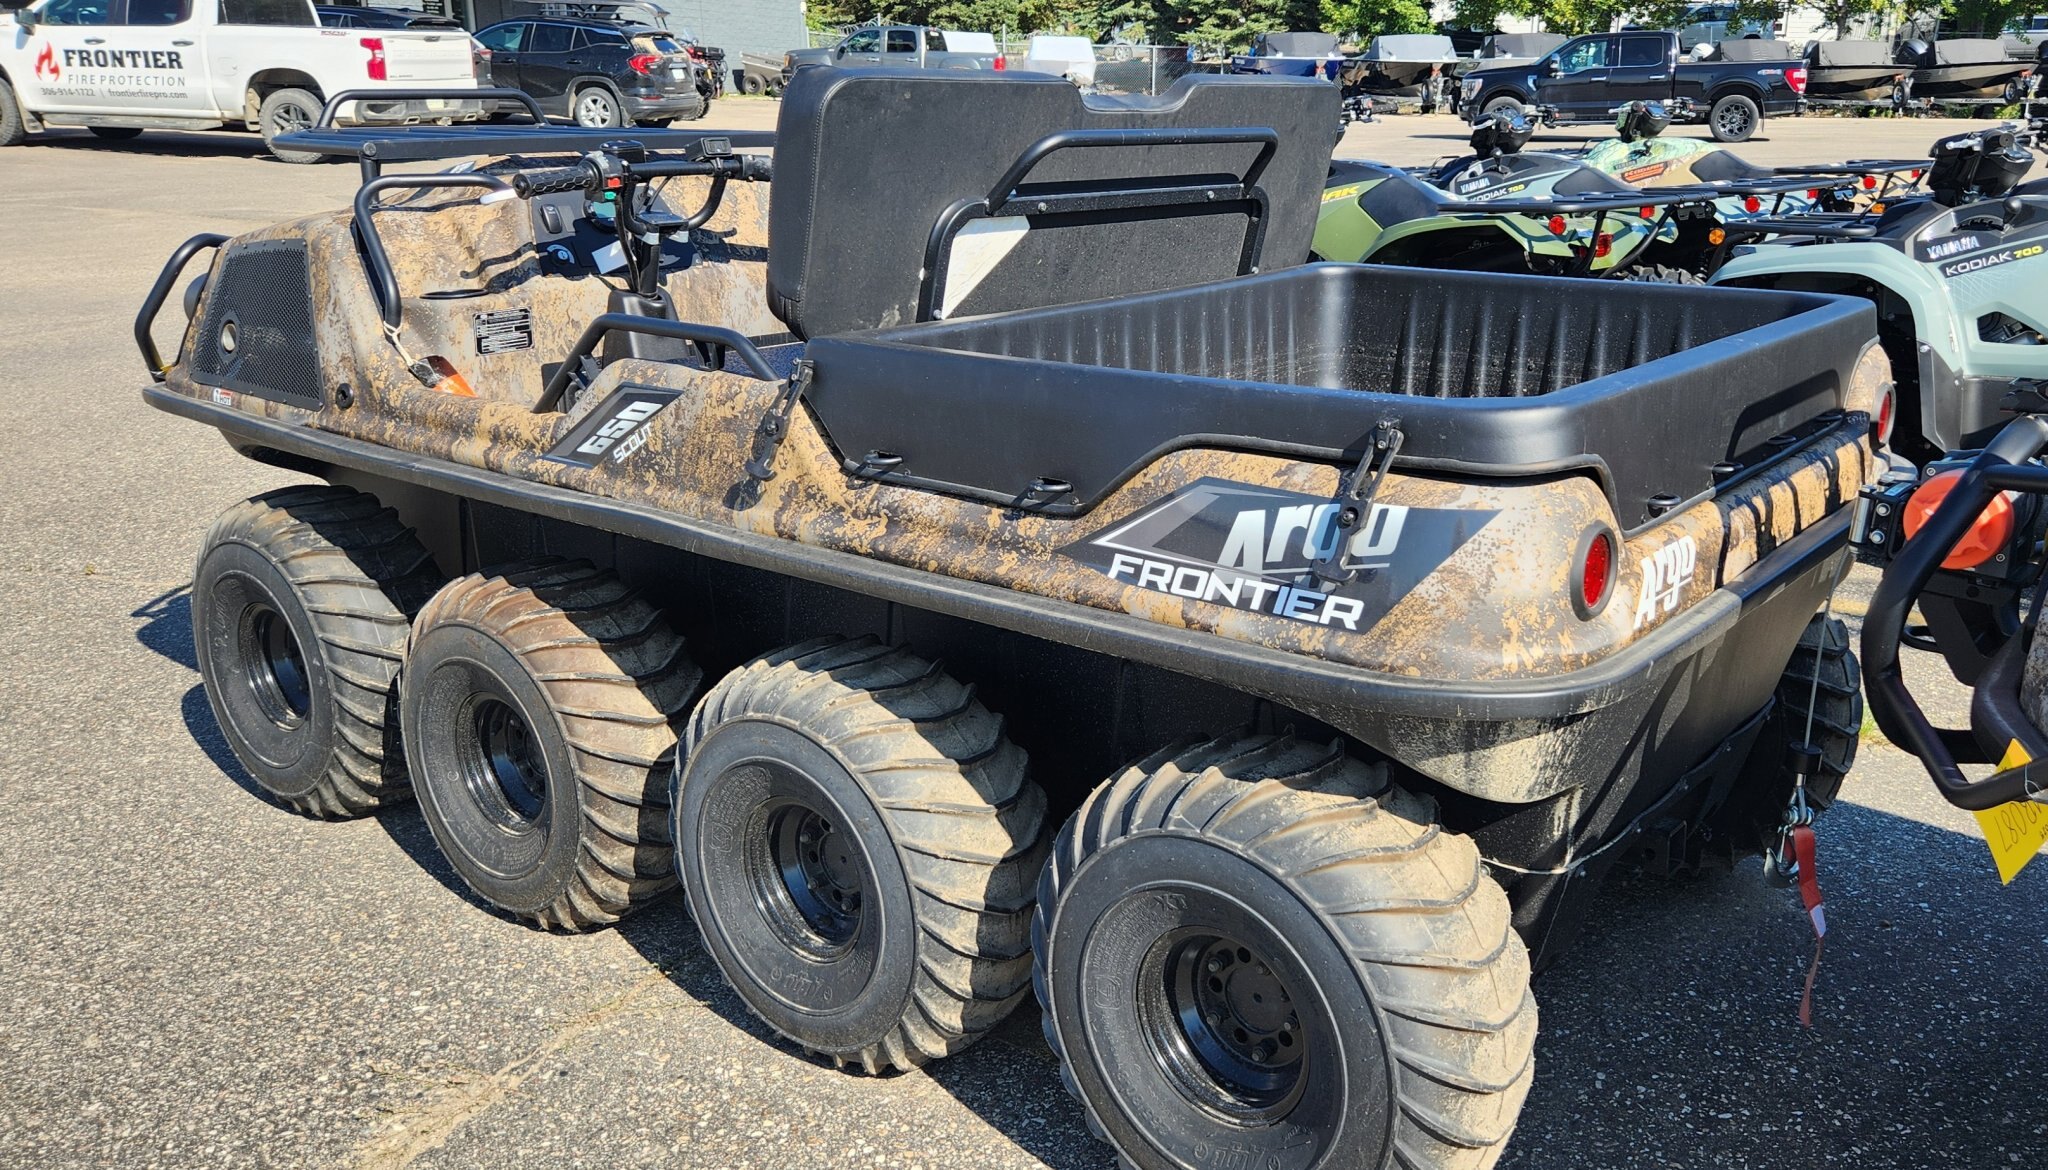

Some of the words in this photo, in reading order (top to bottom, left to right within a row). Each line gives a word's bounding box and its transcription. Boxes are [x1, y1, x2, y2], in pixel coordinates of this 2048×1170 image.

[63, 49, 184, 69] FRONTIER
[68, 74, 96, 85] FIRE
[100, 74, 185, 87] PROTECTION
[1460, 177, 1490, 194] YAMAHA
[1926, 236, 1980, 259] YAMAHA
[1945, 251, 2013, 276] KODIAK
[2013, 245, 2044, 259] 700
[576, 401, 663, 455] 650
[613, 422, 652, 464] SCOUT
[1107, 553, 1365, 631] FRONTIER
[1633, 535, 1697, 630] Argo
